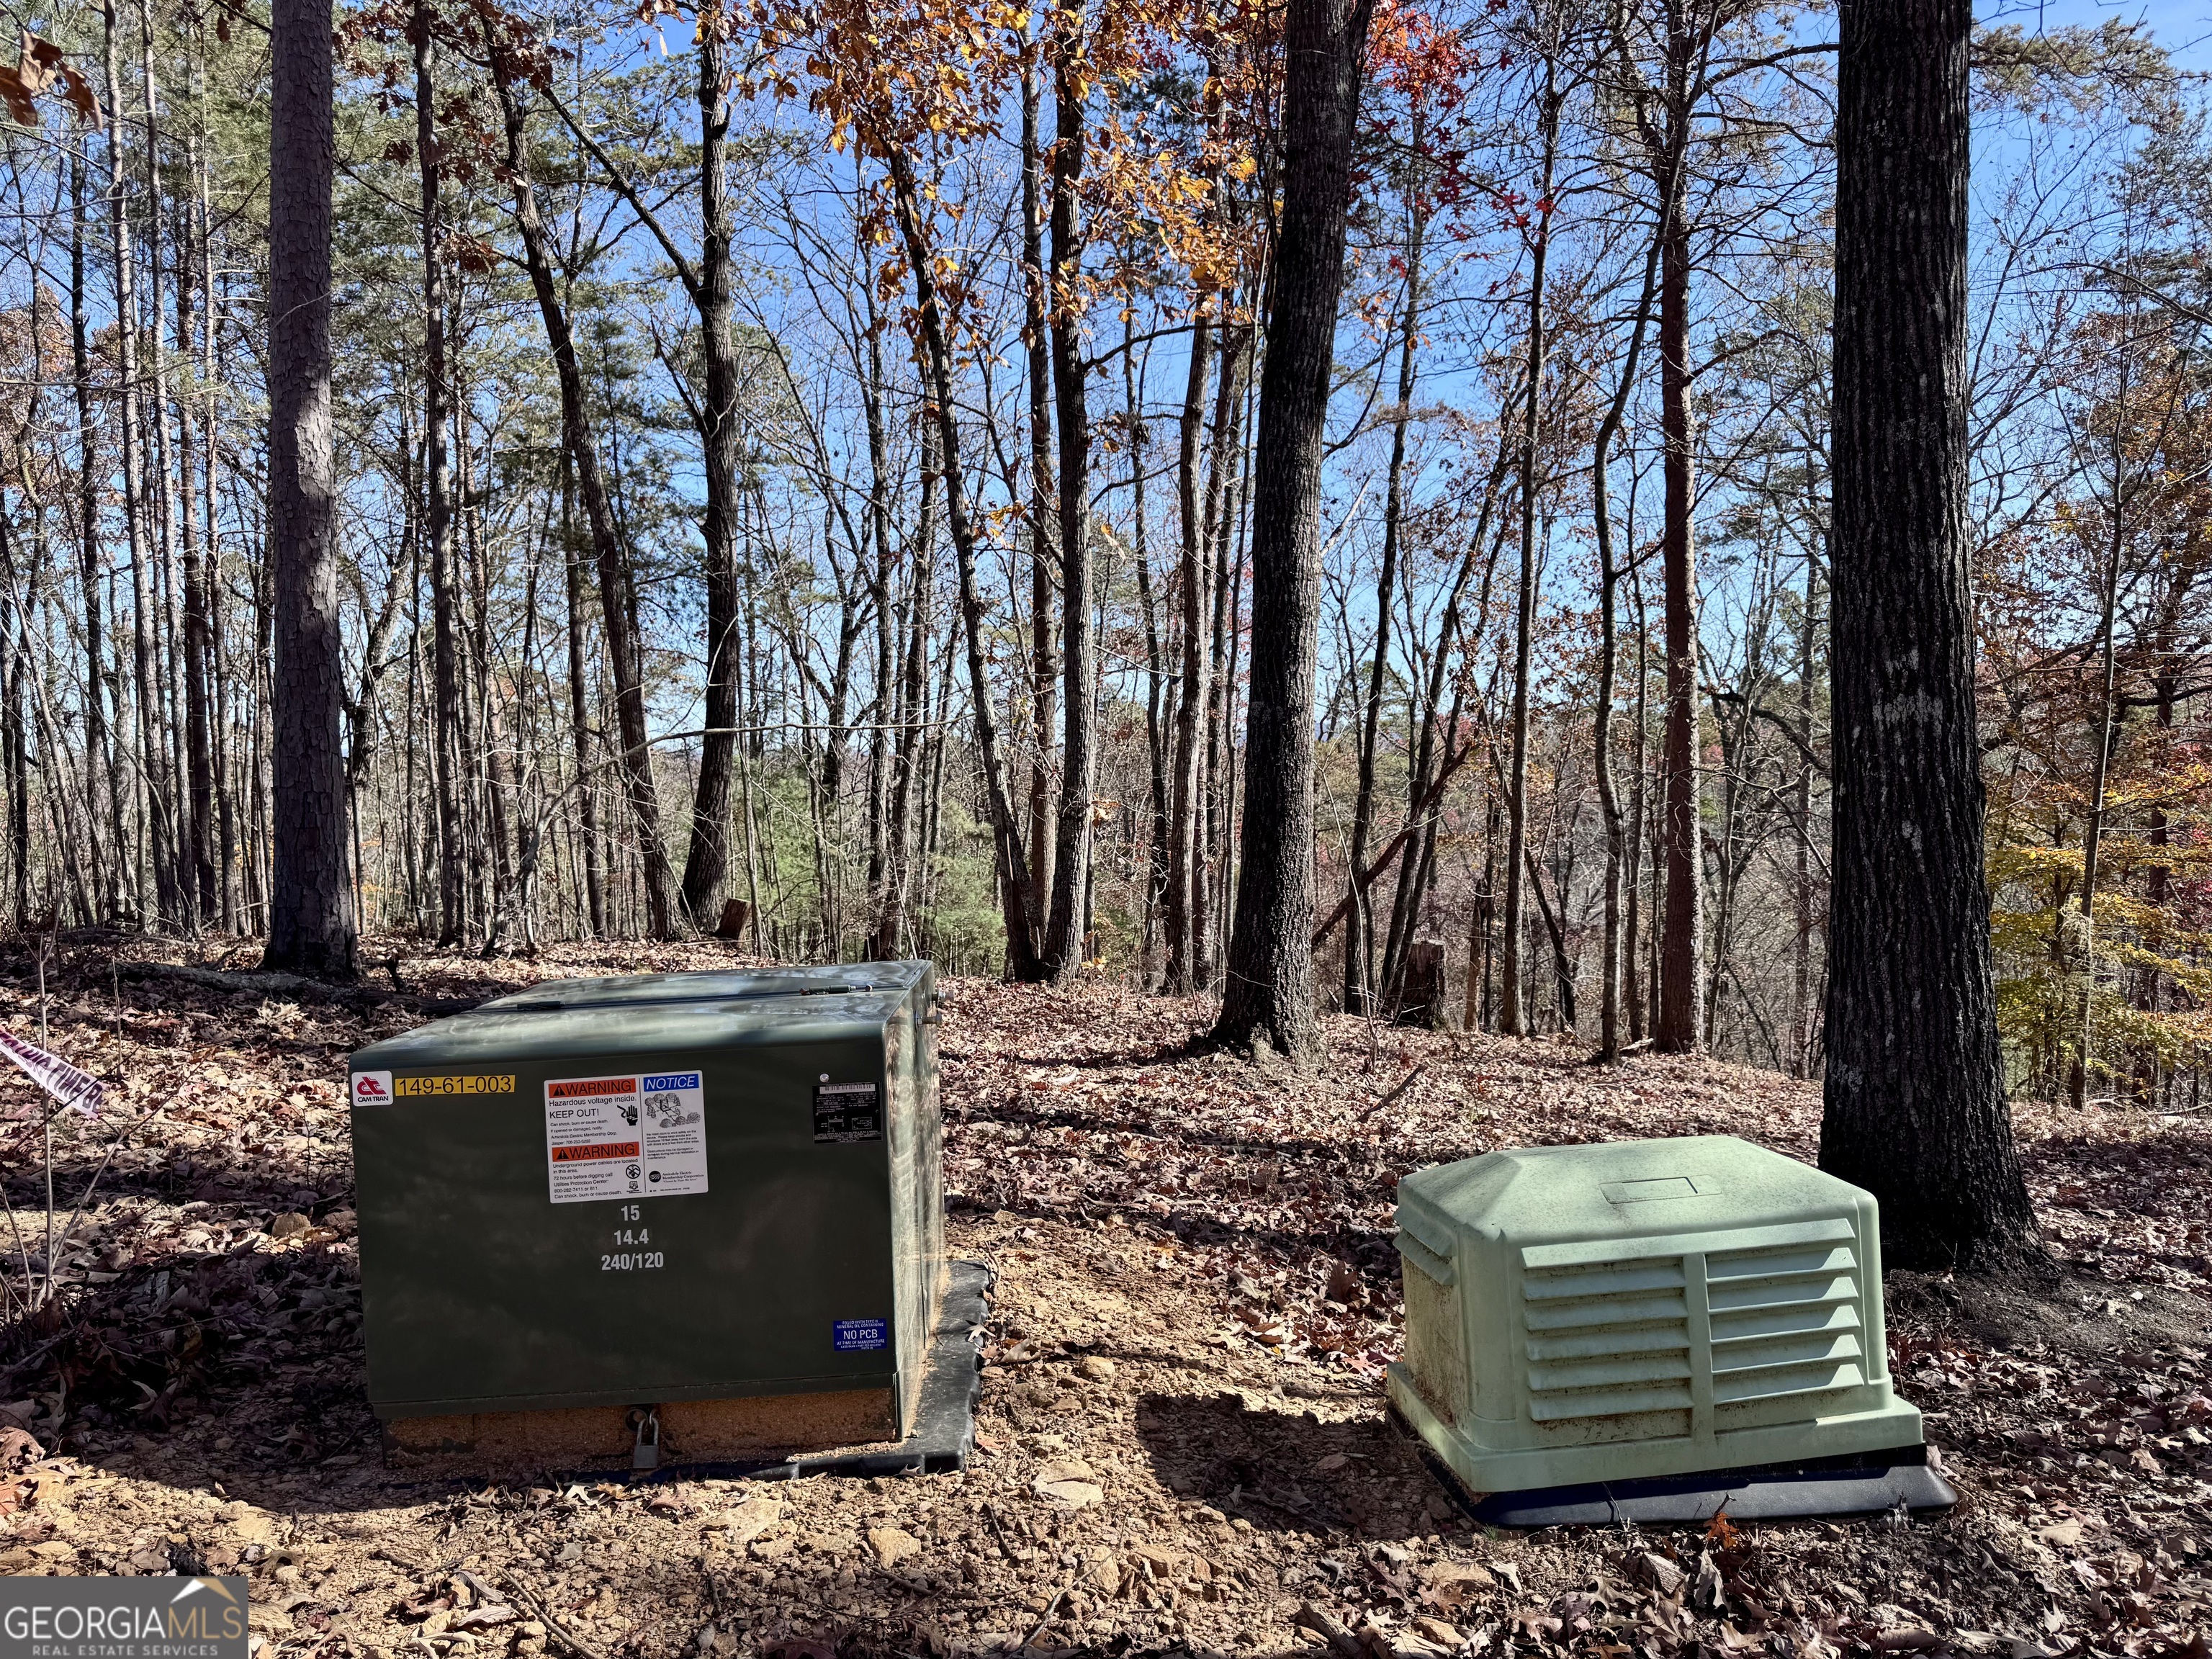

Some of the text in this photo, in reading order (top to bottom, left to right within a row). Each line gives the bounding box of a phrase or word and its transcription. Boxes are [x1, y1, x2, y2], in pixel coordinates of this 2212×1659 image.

[400, 1076, 511, 1095] 149-61-003
[566, 1080, 631, 1095] WARNING
[647, 1076, 695, 1089] NOTICE
[549, 1110, 574, 1119] KEEP
[569, 1143, 635, 1159] WARNING
[621, 1205, 639, 1220] 15
[614, 1228, 649, 1245] 14.4
[601, 1252, 663, 1270] 240/120
[844, 1329, 878, 1339] NO PCB
